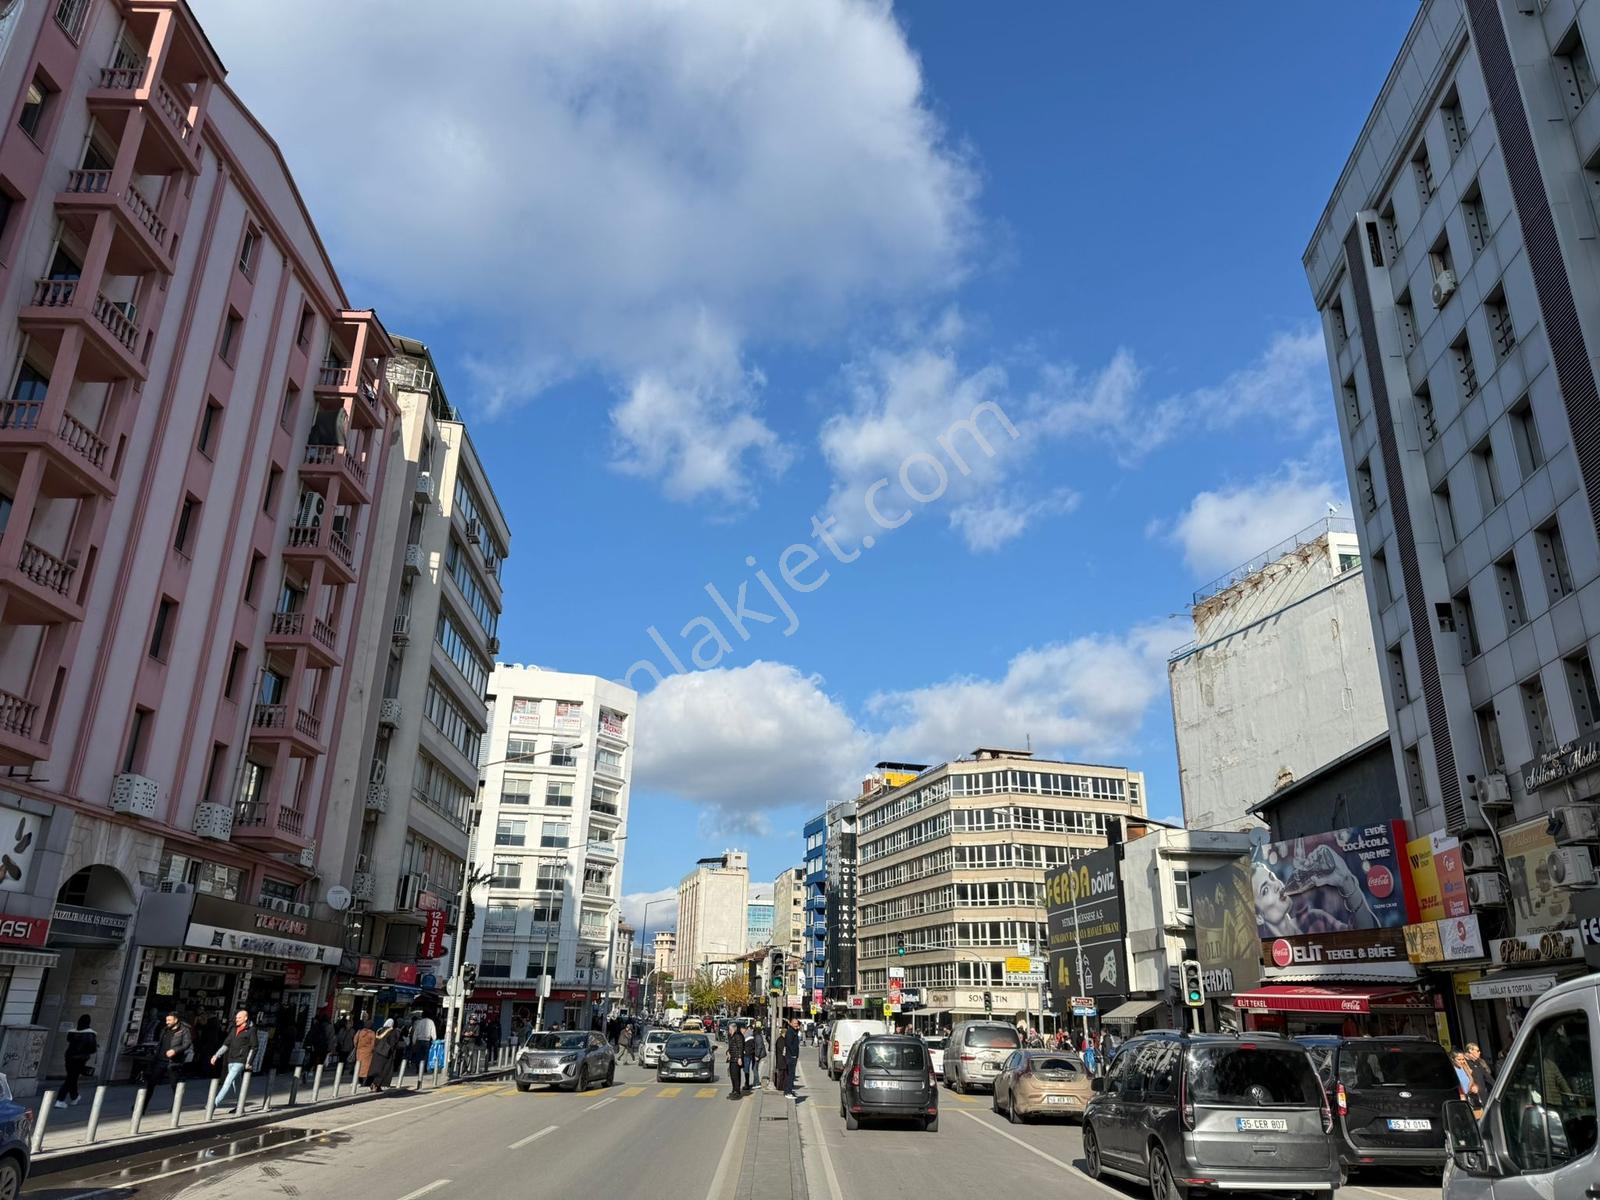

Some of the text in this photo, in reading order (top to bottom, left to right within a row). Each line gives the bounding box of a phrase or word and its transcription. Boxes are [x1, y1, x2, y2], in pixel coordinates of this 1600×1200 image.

[1364, 825, 1387, 836] EVDE
[1342, 837, 1389, 852] COCA-COLA
[1359, 851, 1376, 860] VAR
[427, 920, 440, 957] NOTER
[1293, 942, 1323, 962] ELİT
[1326, 949, 1358, 960] TEKEL
[1358, 948, 1366, 958] &
[1367, 944, 1397, 958] BÜFE
[1341, 1000, 1360, 1010] Coca-Cola
